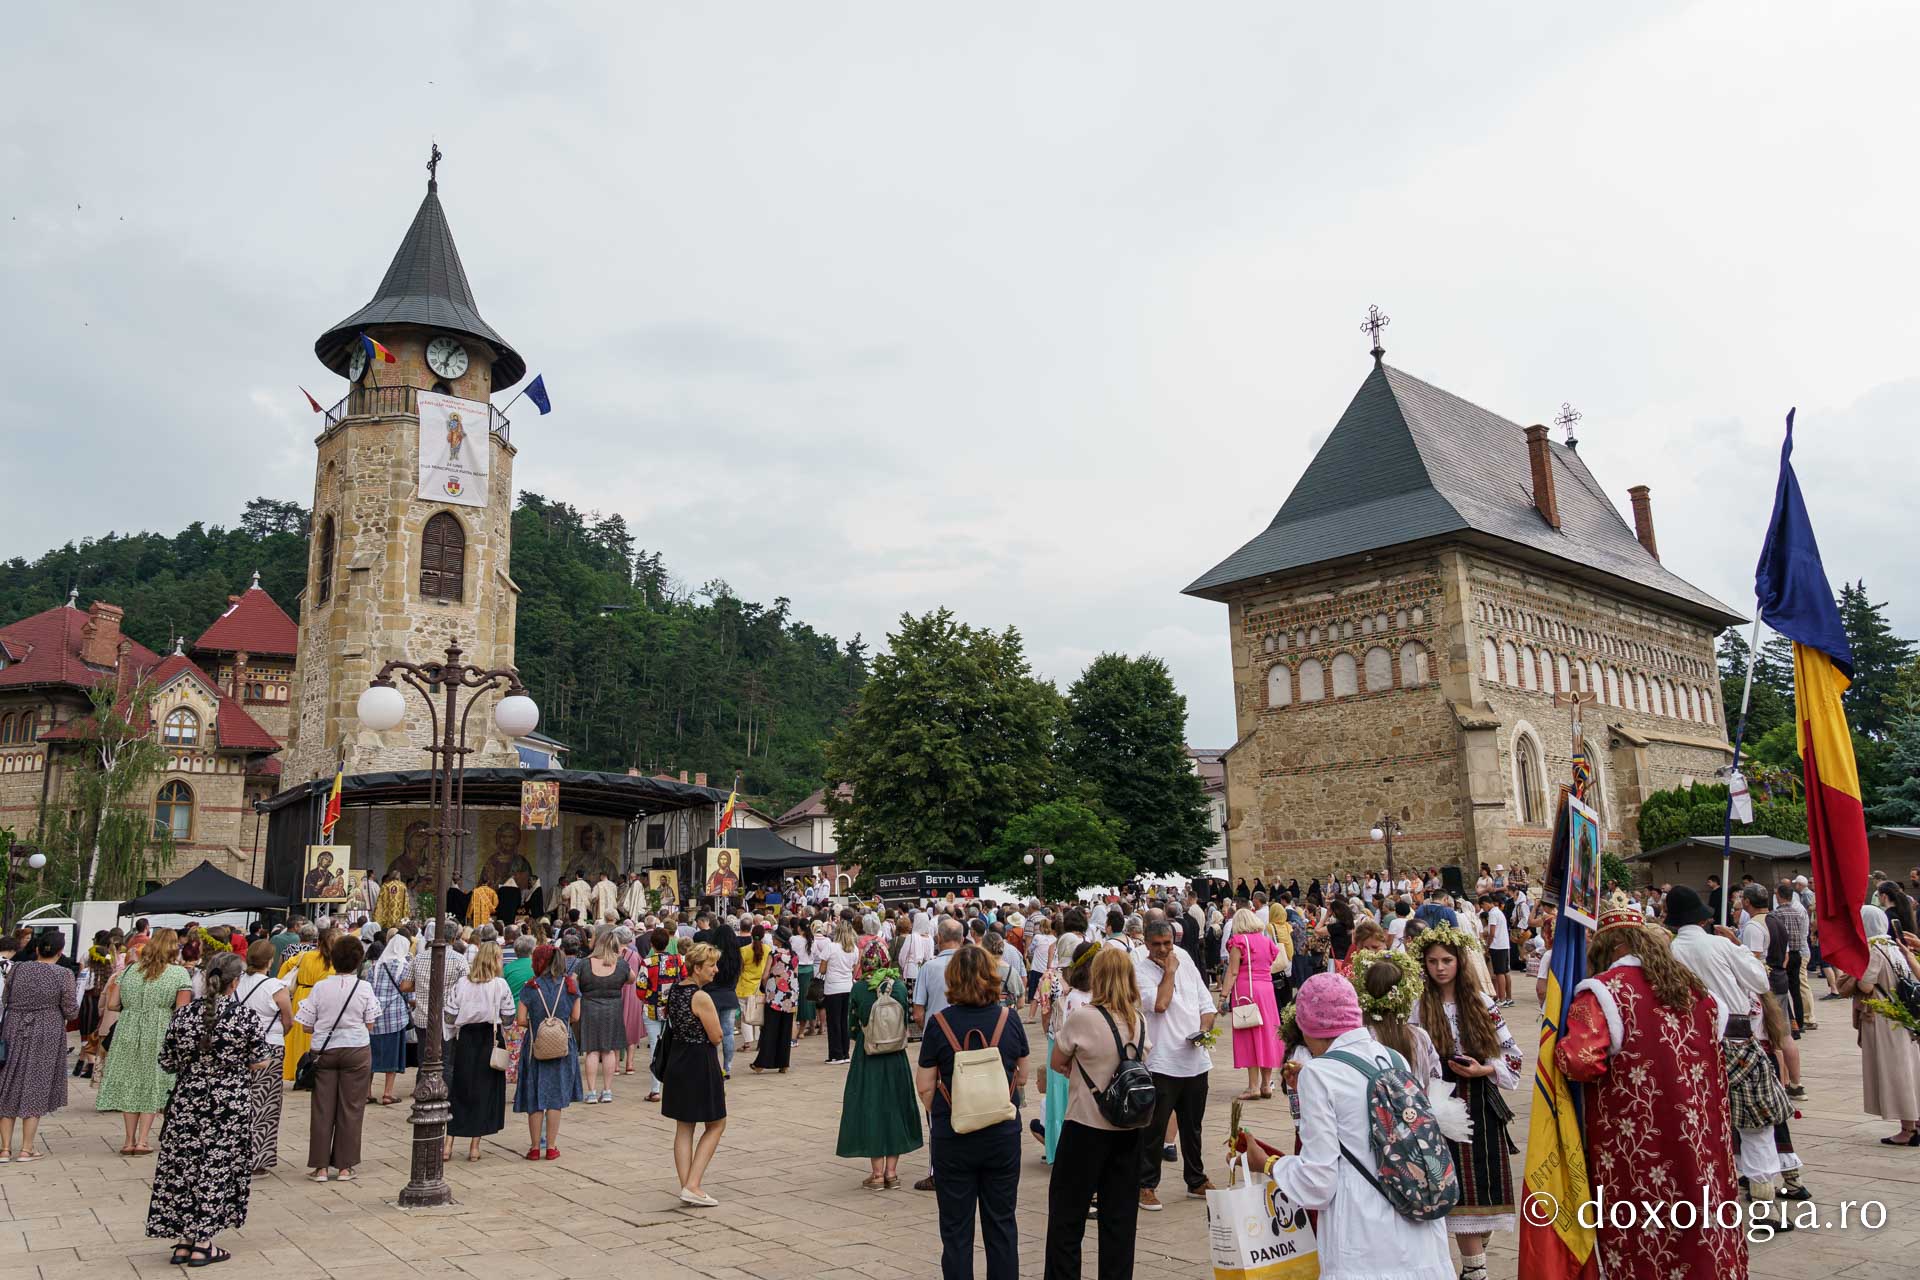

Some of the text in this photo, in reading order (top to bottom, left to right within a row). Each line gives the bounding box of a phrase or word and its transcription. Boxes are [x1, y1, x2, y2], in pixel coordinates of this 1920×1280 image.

[880, 877, 917, 887] BETTY BLUE
[925, 875, 980, 884] BETTY BLUE
[1250, 1241, 1297, 1263] PANDA
